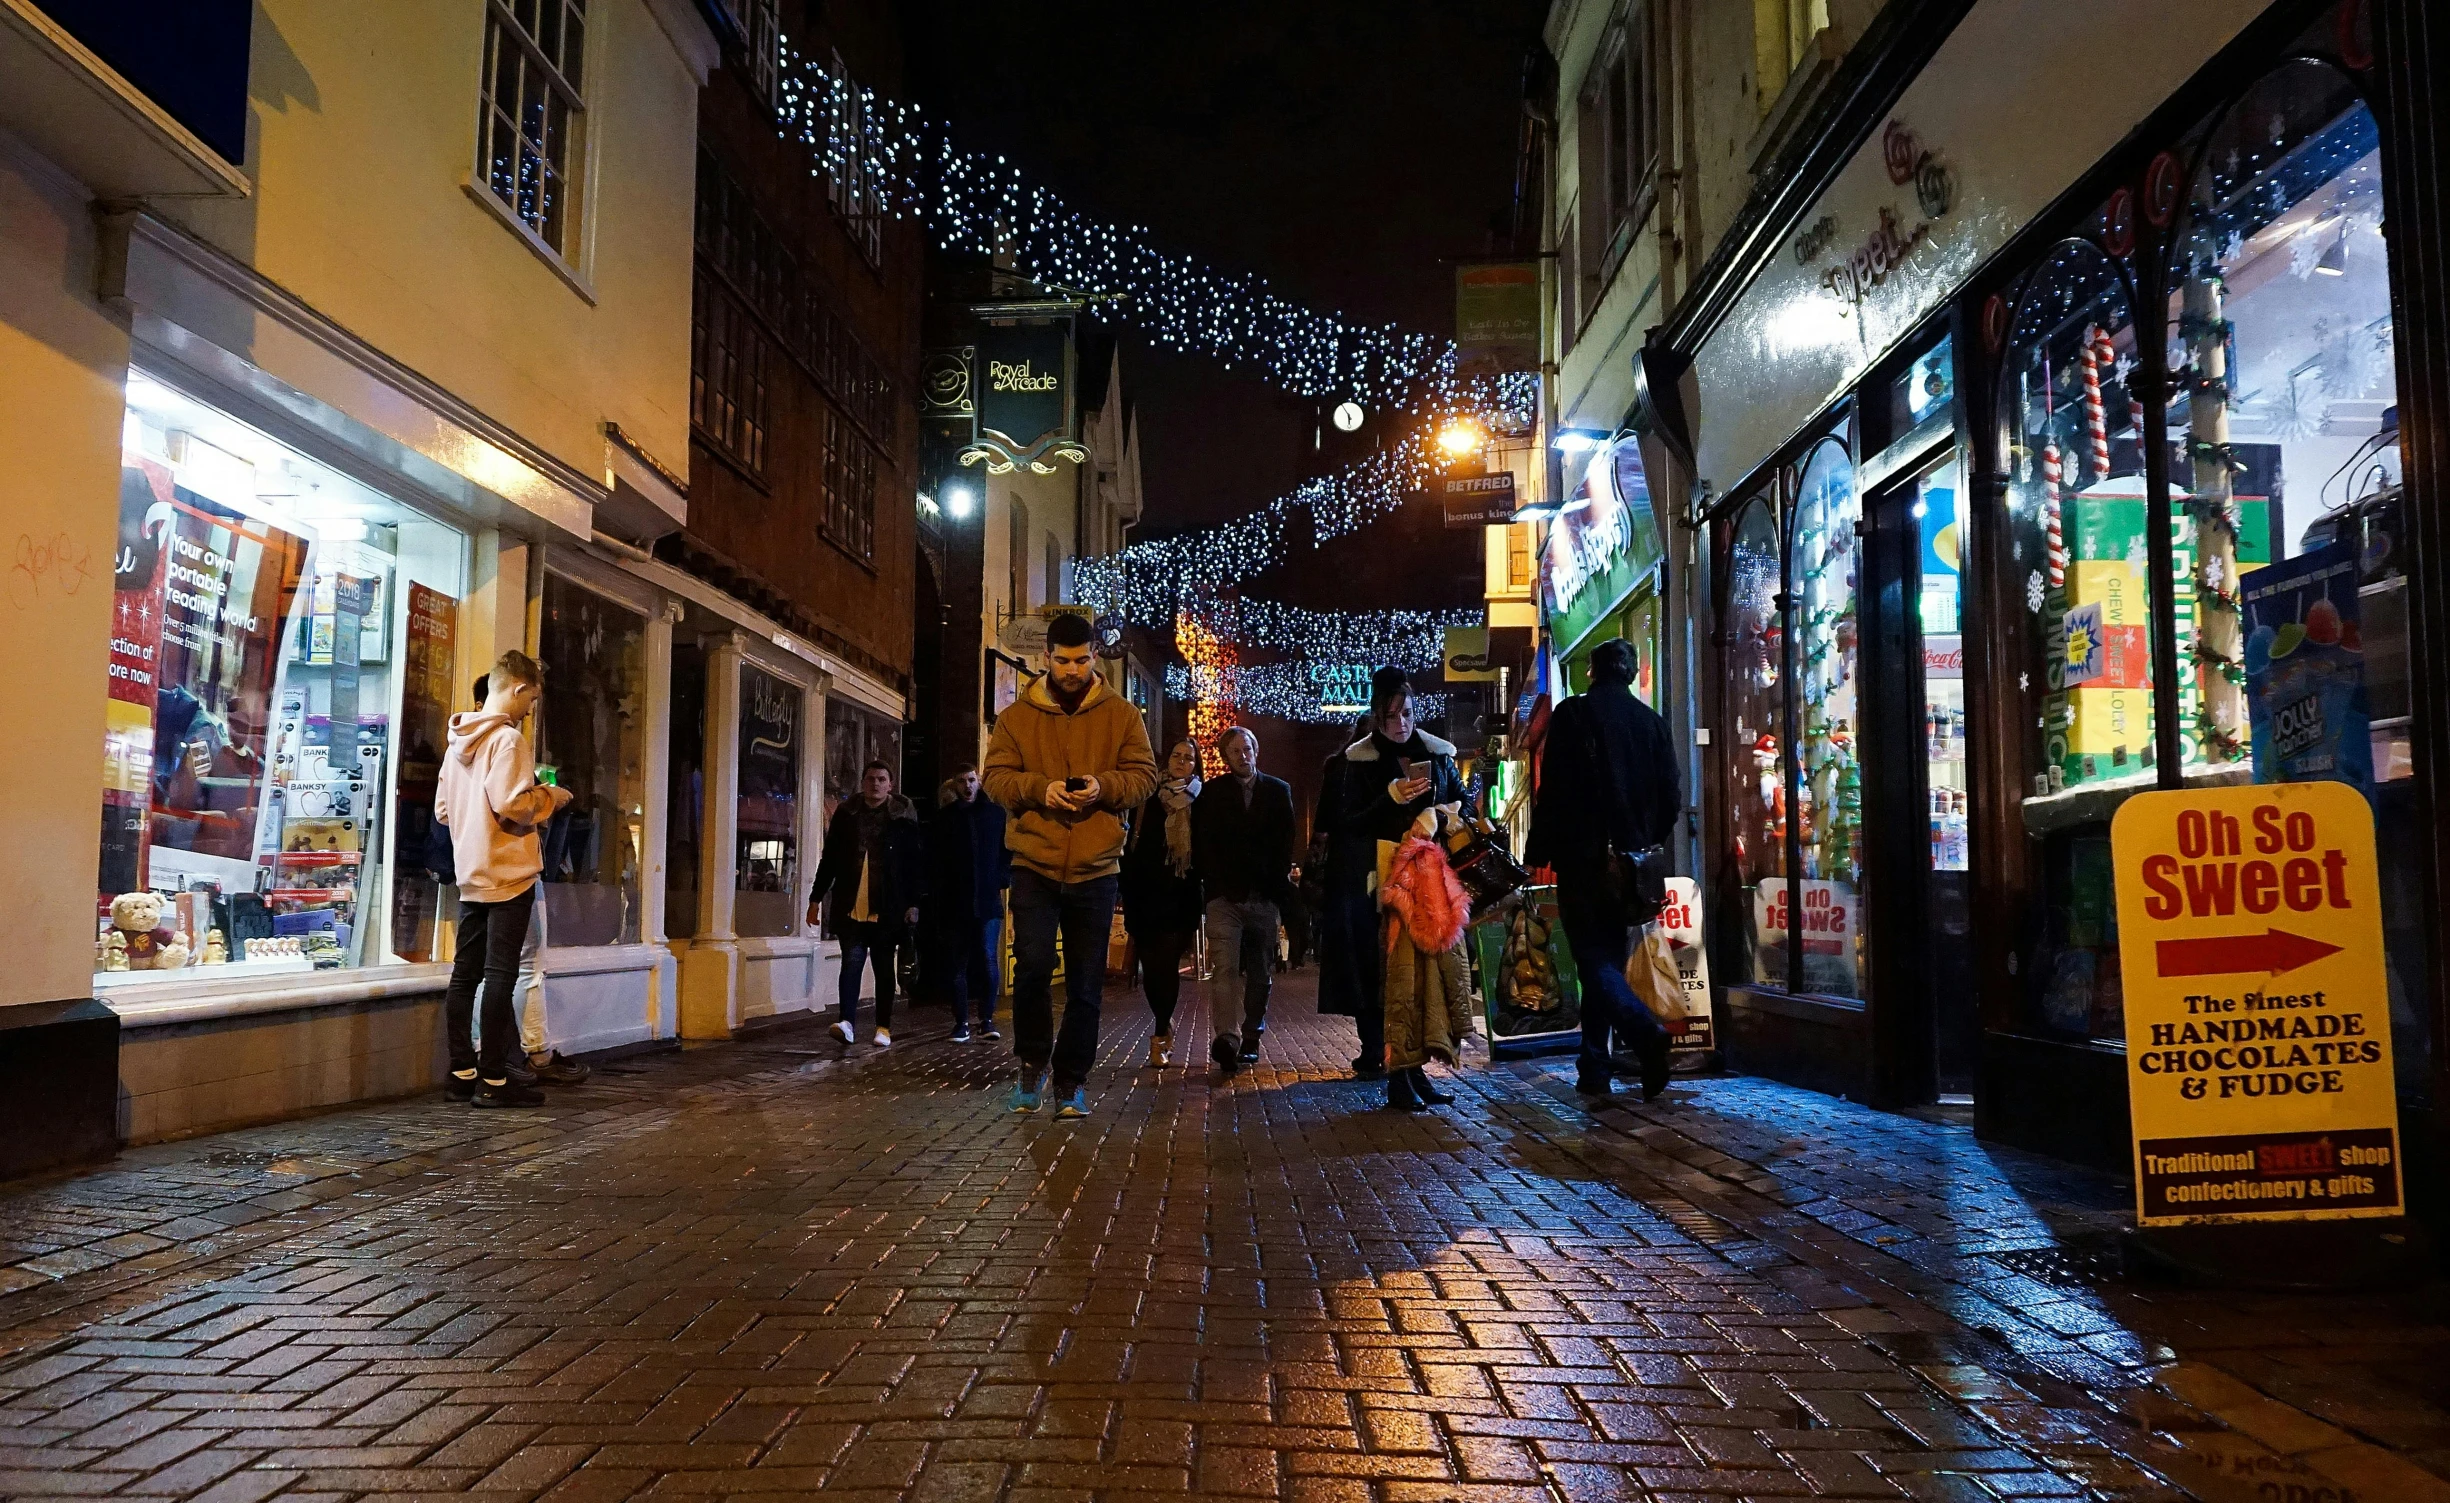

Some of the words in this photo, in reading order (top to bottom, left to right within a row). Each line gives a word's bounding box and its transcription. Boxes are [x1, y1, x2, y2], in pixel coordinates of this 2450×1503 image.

[990, 359, 1030, 380] Royal
[994, 372, 1057, 391] Arcade
[1446, 476, 1512, 493] BETFRED
[1448, 511, 1484, 522] bonus
[172, 534, 203, 560] Your
[203, 550, 235, 575] own
[169, 561, 227, 598] portable
[338, 579, 360, 601] 2018
[165, 585, 217, 621] reading
[219, 608, 257, 633] world
[417, 592, 447, 617] GREAT
[1052, 608, 1089, 616] INKBOX
[2108, 578, 2123, 631] CHEWY
[162, 613, 180, 630] Over
[412, 613, 449, 640] OFFERS
[142, 645, 153, 660] of
[162, 629, 184, 647] choose
[184, 635, 202, 652] from
[2109, 634, 2125, 686] SWEET
[130, 668, 152, 685] now
[2111, 690, 2125, 735] LOLLY
[2274, 694, 2319, 740] JOLLY
[290, 783, 327, 791] BANKSY
[2177, 809, 2242, 858] Oh
[2252, 804, 2315, 855] So
[2142, 848, 2352, 921] Sweet
[2184, 995, 2236, 1014] The
[2244, 990, 2326, 1011] finest
[1689, 1022, 1709, 1032] shop
[2150, 1013, 2365, 1046] HANDMADE
[2139, 1040, 2382, 1074] CHOCOLATES
[2180, 1077, 2208, 1100] &
[2218, 1070, 2344, 1098] FUDGE
[2145, 1150, 2256, 1175] Traditional
[2339, 1145, 2391, 1168] shop
[2165, 1178, 2306, 1203] confectionery
[2309, 1179, 2325, 1197] &
[2328, 1175, 2375, 1199] gifts
